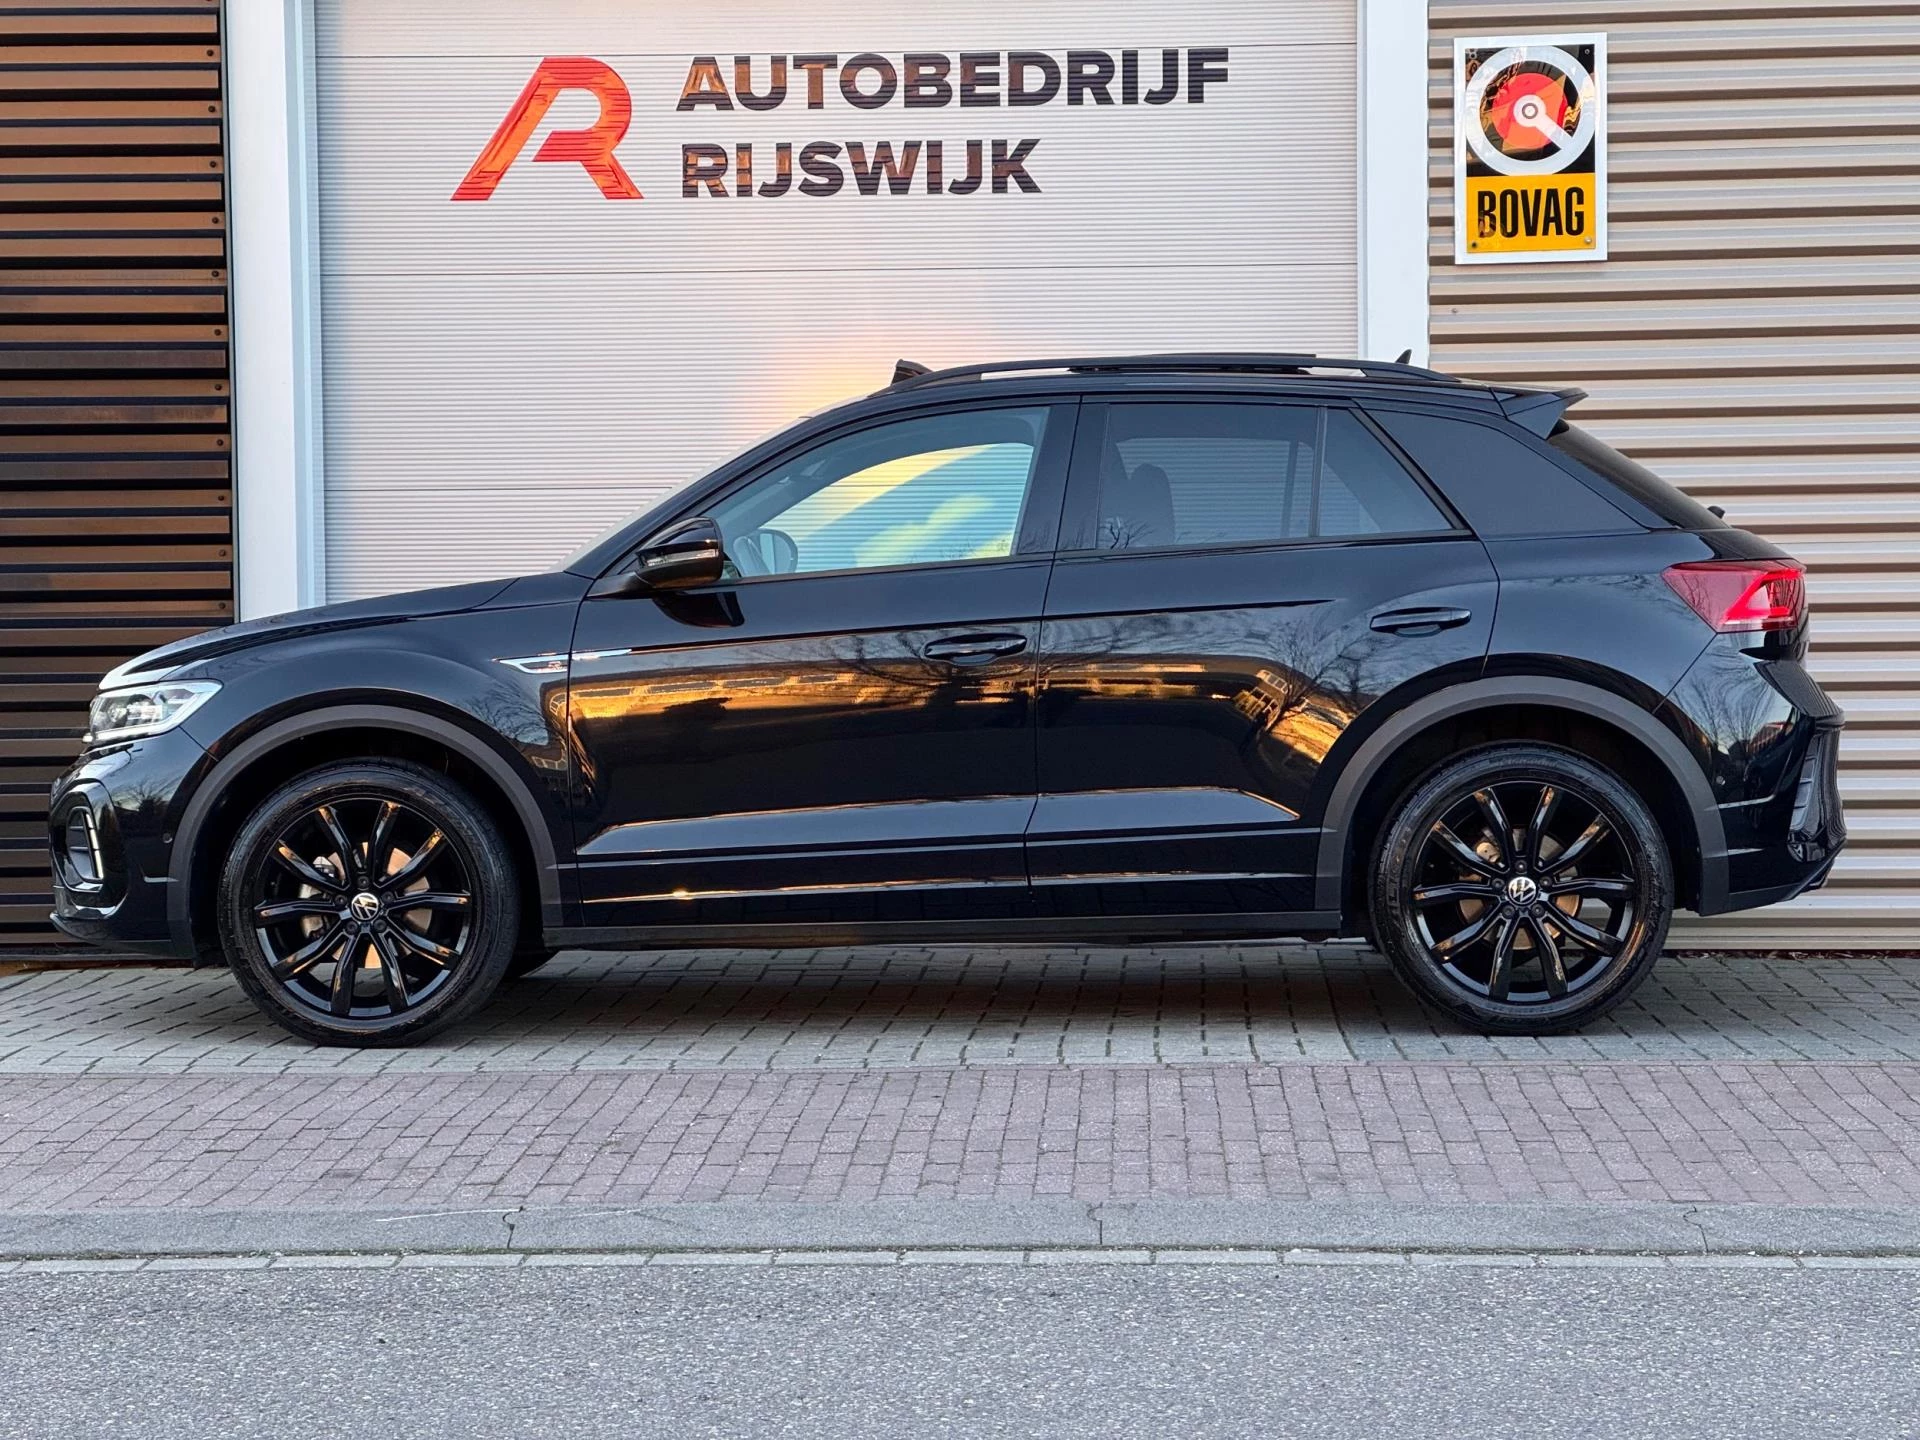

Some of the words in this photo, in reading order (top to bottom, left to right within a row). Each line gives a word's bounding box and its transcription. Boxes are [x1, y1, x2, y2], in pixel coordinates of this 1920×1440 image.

[675, 47, 1229, 112] AUTOBEDRIJF
[681, 138, 1042, 198] RIJSWIJK
[1477, 186, 1585, 239] BOVAG
